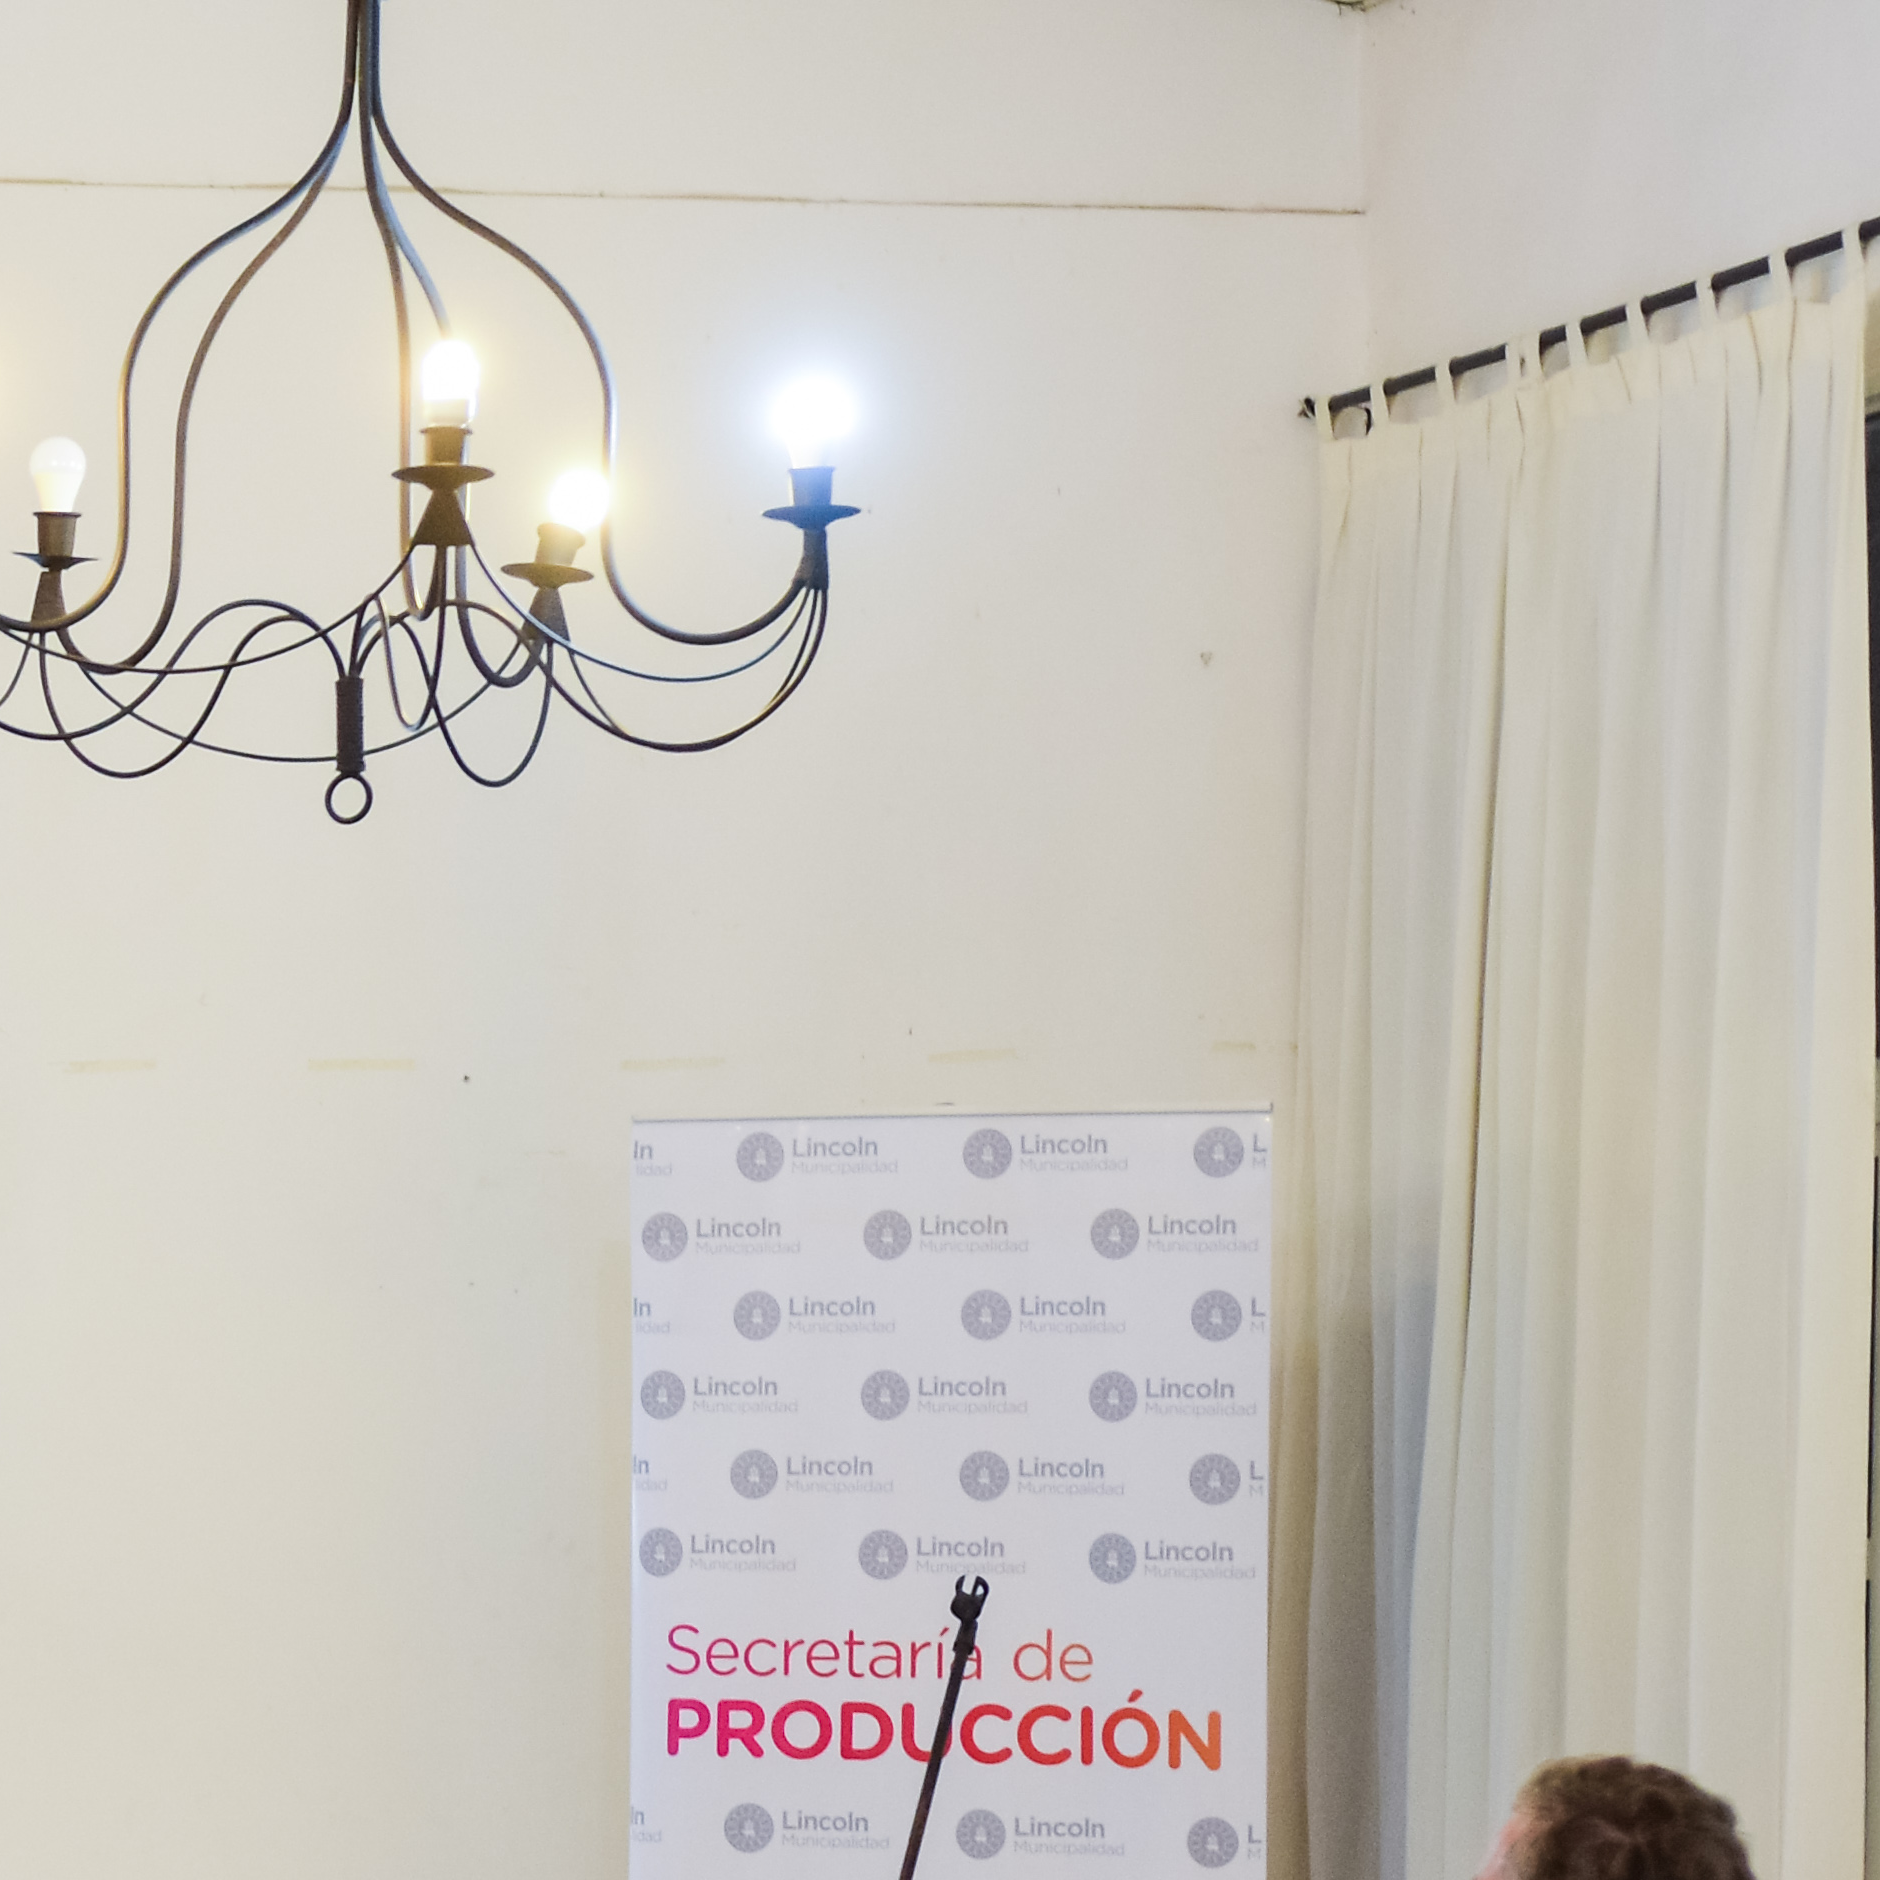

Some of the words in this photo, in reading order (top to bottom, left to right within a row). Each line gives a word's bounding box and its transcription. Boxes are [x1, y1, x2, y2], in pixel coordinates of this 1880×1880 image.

[792, 1136, 879, 1158] Lincoln
[1020, 1134, 1108, 1155] Lincoln
[696, 1217, 782, 1238] Lincoln
[920, 1215, 1009, 1236] Lincoln
[1148, 1215, 1237, 1236] Lincoln
[789, 1296, 876, 1317] Lincoln
[1019, 1296, 1106, 1317] Lincoln
[693, 1376, 779, 1397] Lincoln
[918, 1376, 1007, 1397] Lincoln
[1145, 1378, 1235, 1399] Lincoln
[786, 1456, 873, 1477] Lincoln
[1018, 1458, 1105, 1479] Lincoln
[690, 1535, 776, 1556] Lincoln
[916, 1537, 1005, 1557] Lincoln
[1144, 1541, 1234, 1562] Lincoln
[666, 1623, 984, 1681] Secretaría
[1012, 1627, 1094, 1683] de
[666, 1689, 1222, 1771] PRODUCCIÓN
[782, 1811, 869, 1832] Lincoln
[1014, 1817, 1105, 1839] Lincoln
